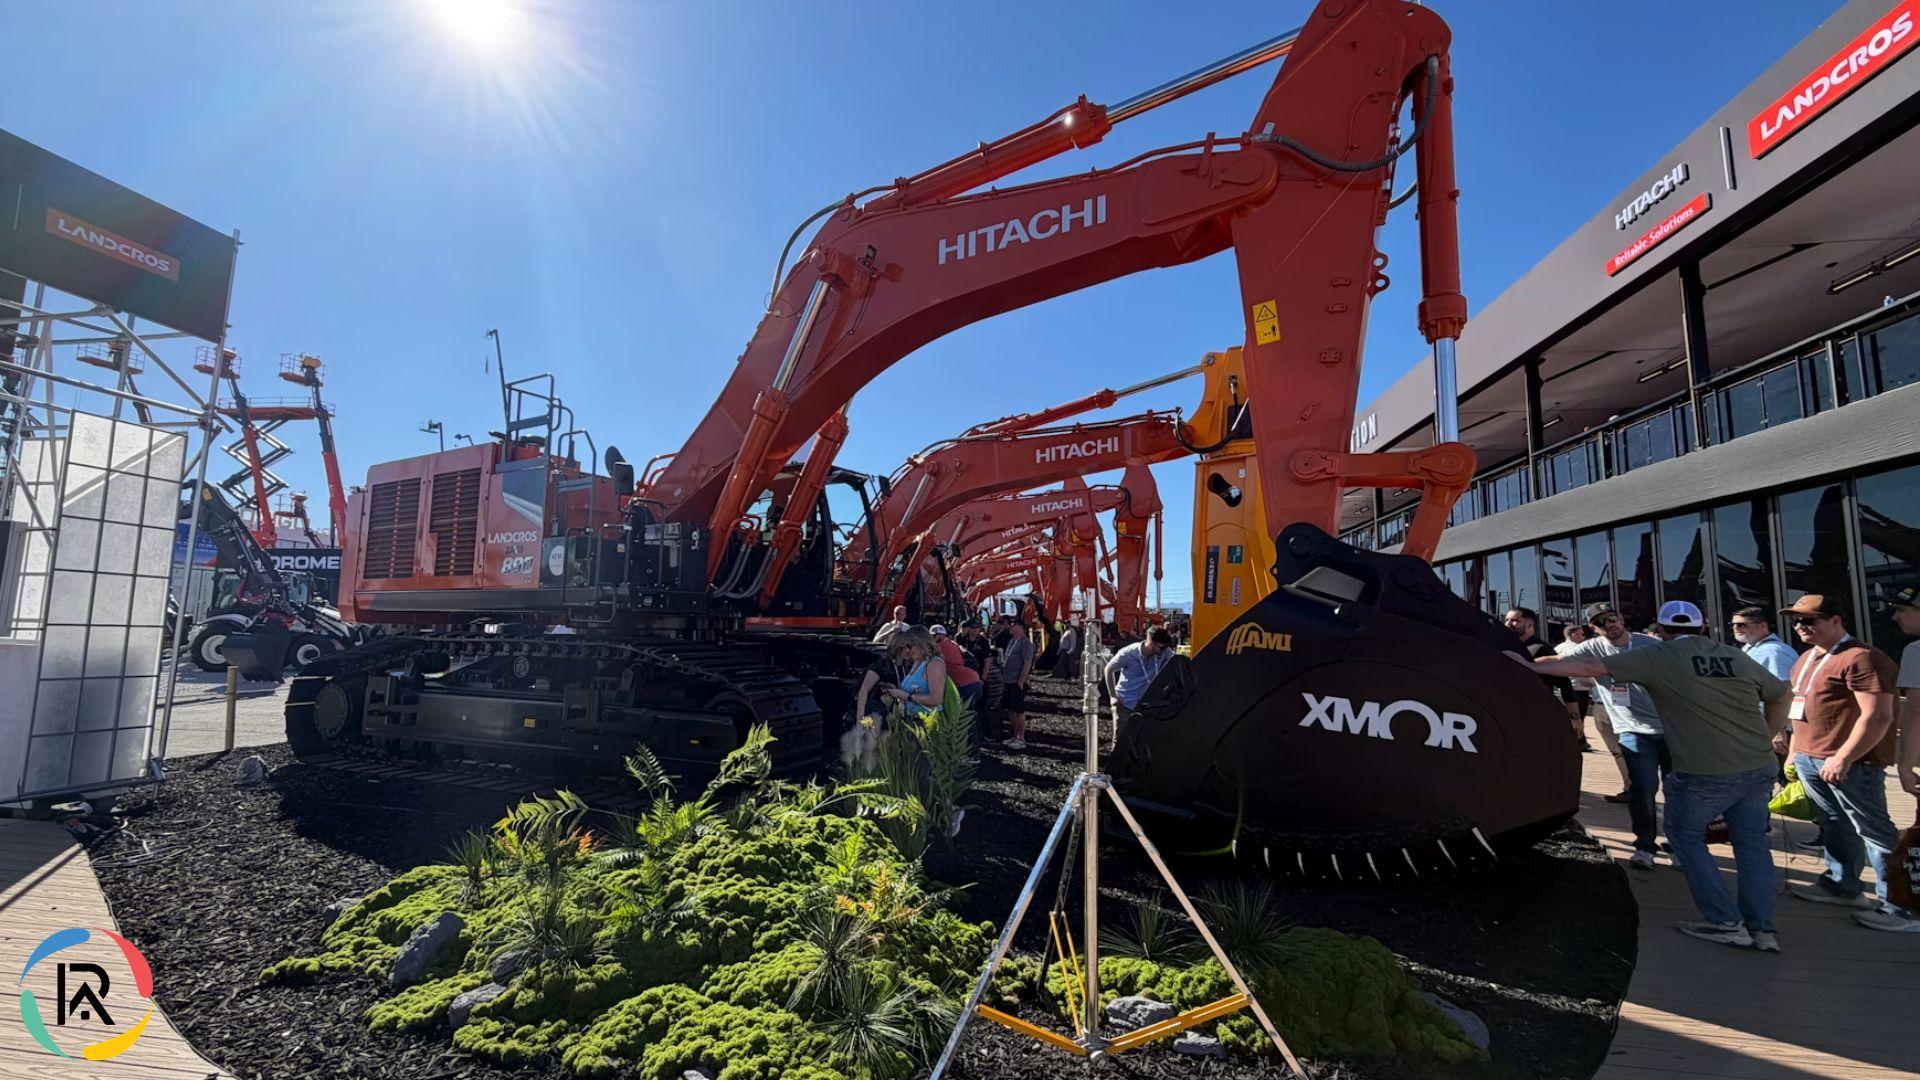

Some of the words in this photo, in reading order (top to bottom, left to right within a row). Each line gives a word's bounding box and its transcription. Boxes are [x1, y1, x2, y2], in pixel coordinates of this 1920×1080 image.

[1759, 10, 1914, 141] LANDCROS
[1614, 162, 1689, 231] HITACHI
[937, 194, 1108, 265] HITACHI
[1613, 236, 1648, 267] Reliable
[1648, 205, 1695, 245] Solutions
[57, 217, 172, 273] LANDCROS
[1034, 436, 1120, 465] HITACHI
[1031, 497, 1084, 514] HITACHI
[487, 530, 538, 544] LANDCROS
[259, 555, 342, 570] DROME
[501, 556, 535, 575] 890
[1006, 558, 1037, 569] HITACHI
[1691, 654, 1737, 679] CAT
[1298, 691, 1479, 754] XMOR
